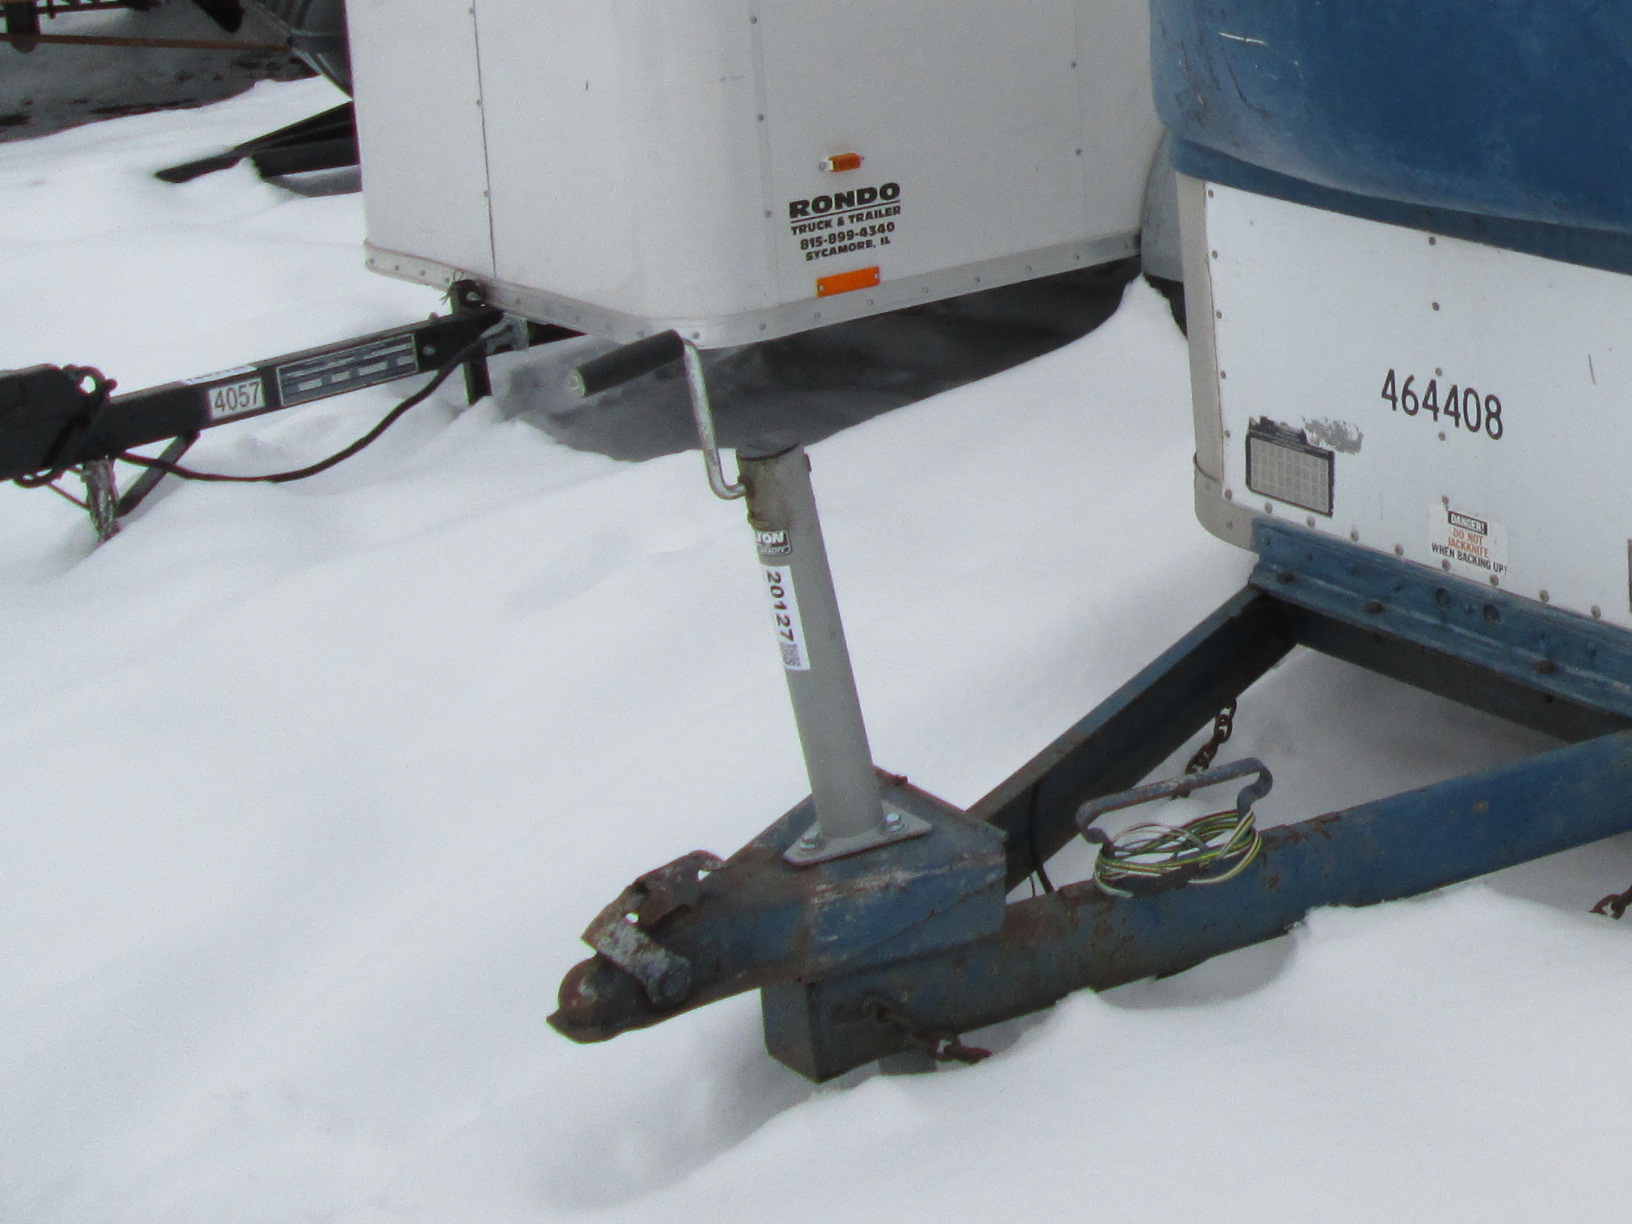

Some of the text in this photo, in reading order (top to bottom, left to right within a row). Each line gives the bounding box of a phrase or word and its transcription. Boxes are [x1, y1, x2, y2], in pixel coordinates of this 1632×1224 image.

[789, 182, 900, 218] RONDO
[791, 205, 901, 236] TRUCK & TRAILER
[800, 222, 895, 250] 815-899-4340
[806, 236, 891, 261] SYCAMORE, IL
[214, 381, 261, 413] 4057
[1381, 368, 1503, 440] 464408
[1451, 513, 1485, 533] DANGER!
[1453, 528, 1483, 545] DO NOT
[1431, 542, 1507, 575] WHEN BACKING UP!
[1448, 537, 1489, 558] JACKKNIFE
[767, 570, 795, 642] 20127
